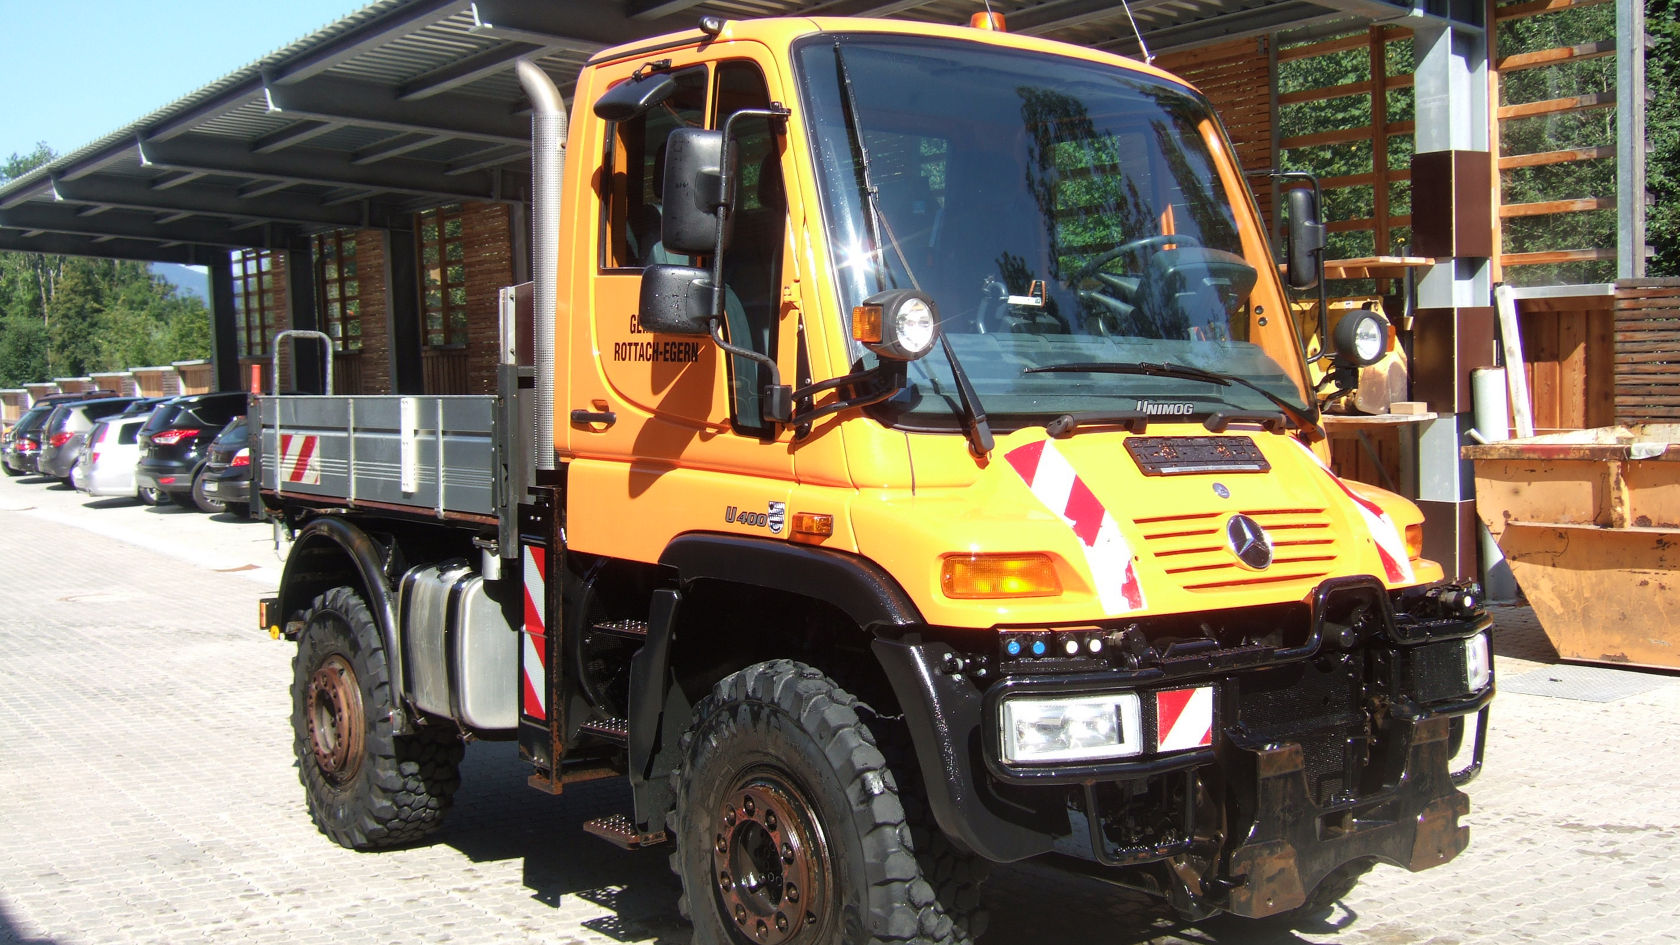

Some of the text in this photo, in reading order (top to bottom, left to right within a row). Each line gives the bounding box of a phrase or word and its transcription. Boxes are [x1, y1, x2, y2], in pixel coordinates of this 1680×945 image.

[614, 341, 699, 363] ROTTACH-EGERN
[1136, 400, 1194, 415] UNIMOG
[725, 505, 738, 523] U
[736, 511, 768, 527] 400
